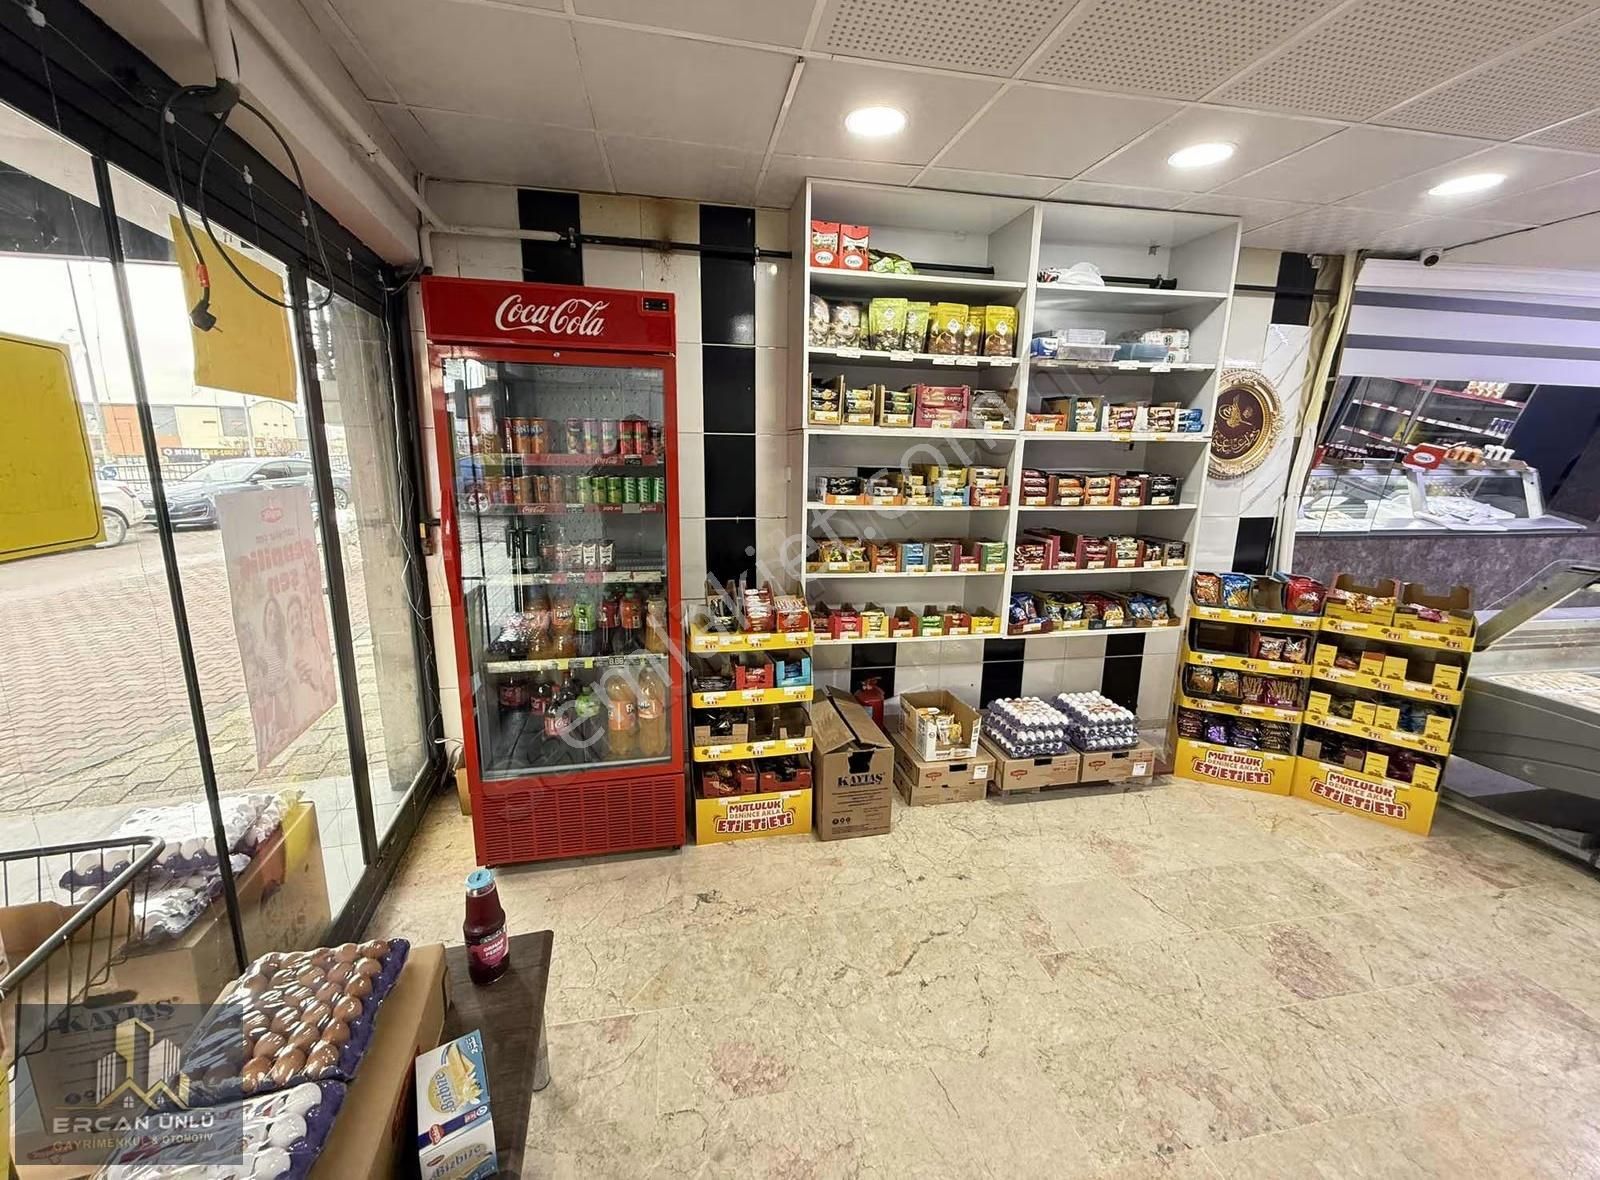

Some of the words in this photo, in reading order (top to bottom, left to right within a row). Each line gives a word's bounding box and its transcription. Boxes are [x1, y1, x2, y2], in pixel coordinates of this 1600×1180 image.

[495, 294, 609, 337] Coca-Cola
[1208, 751, 1261, 766] MUTLULUK
[1329, 774, 1394, 797] MUTLULUK
[1366, 792, 1391, 802] AKLA
[729, 801, 781, 813] MUTLULUK
[761, 809, 781, 817] AKLA
